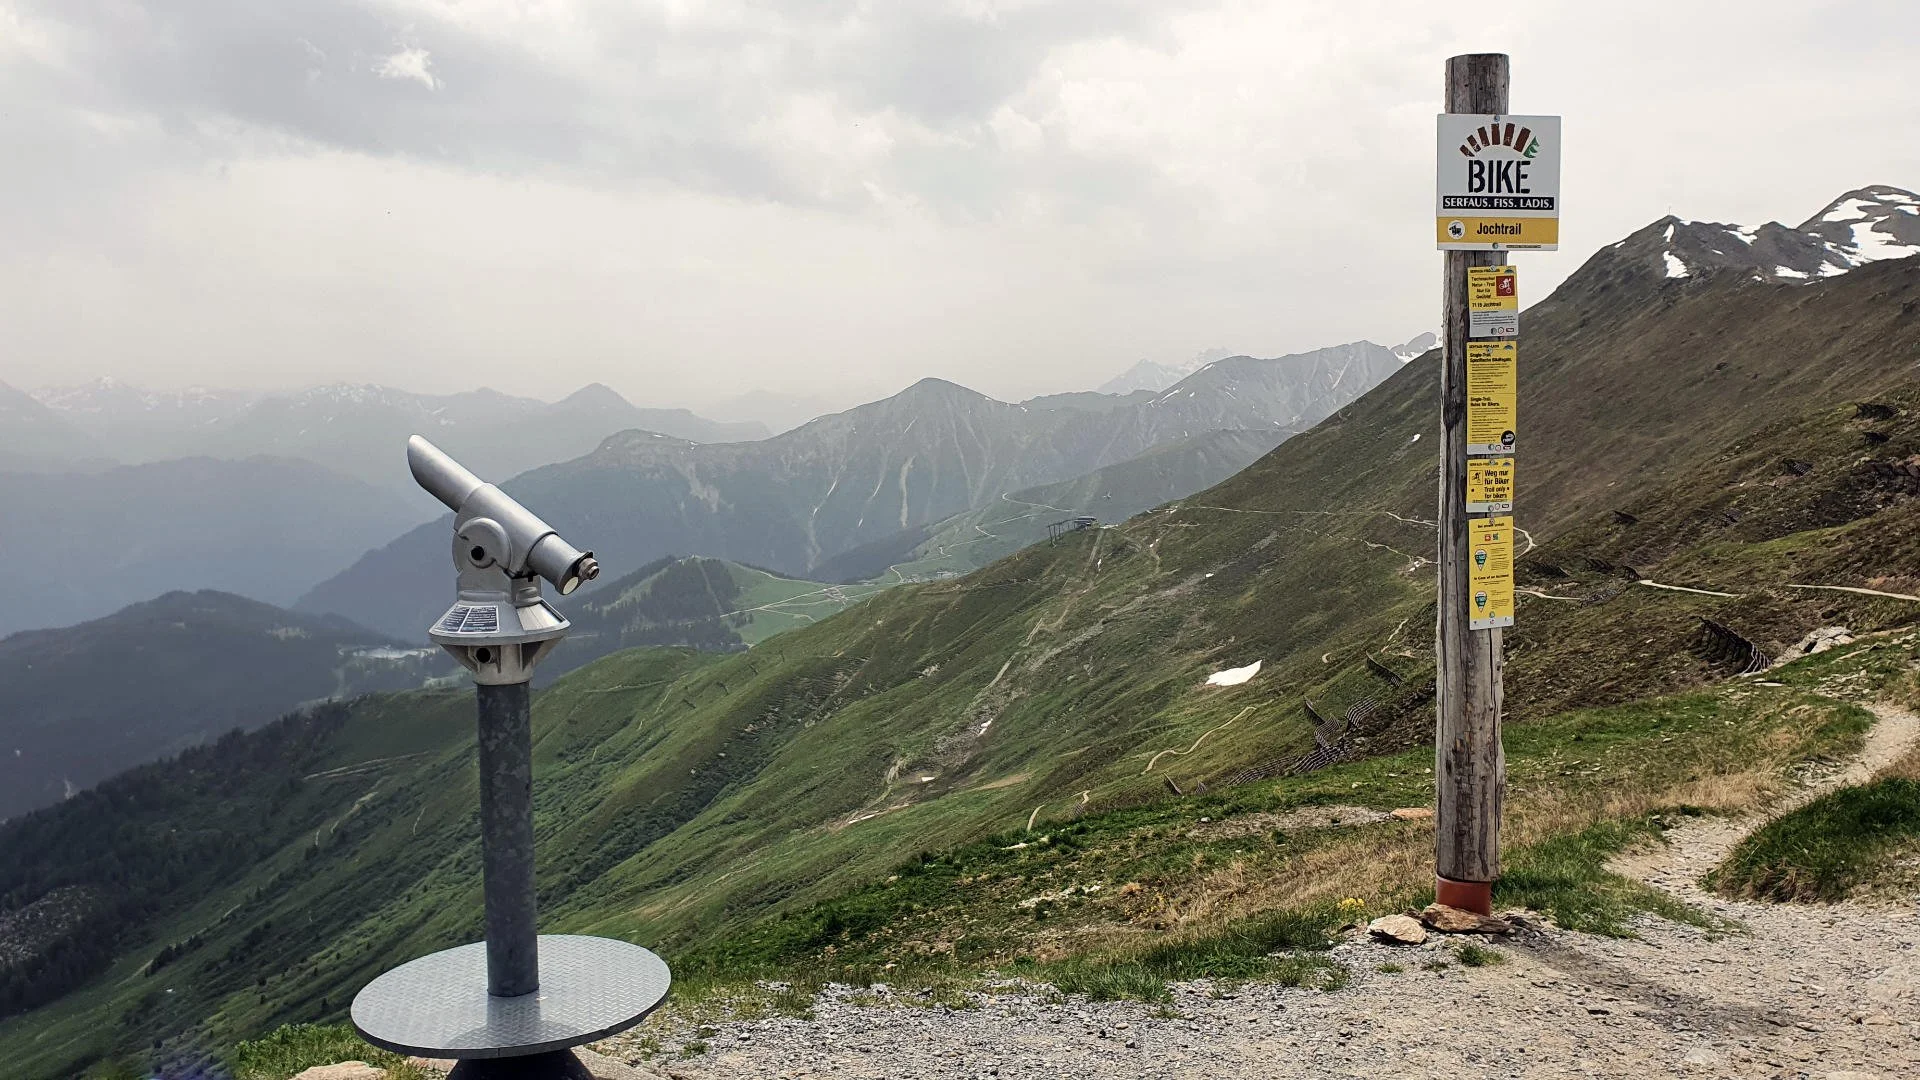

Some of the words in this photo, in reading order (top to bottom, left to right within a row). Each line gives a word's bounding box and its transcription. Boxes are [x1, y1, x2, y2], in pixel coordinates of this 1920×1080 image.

[1468, 160, 1531, 194] BIKE
[1444, 197, 1491, 208] SERFAUS.
[1493, 198, 1517, 208] FISS.
[1520, 199, 1553, 209] LADIS.
[1477, 222, 1522, 235] Jochtrail
